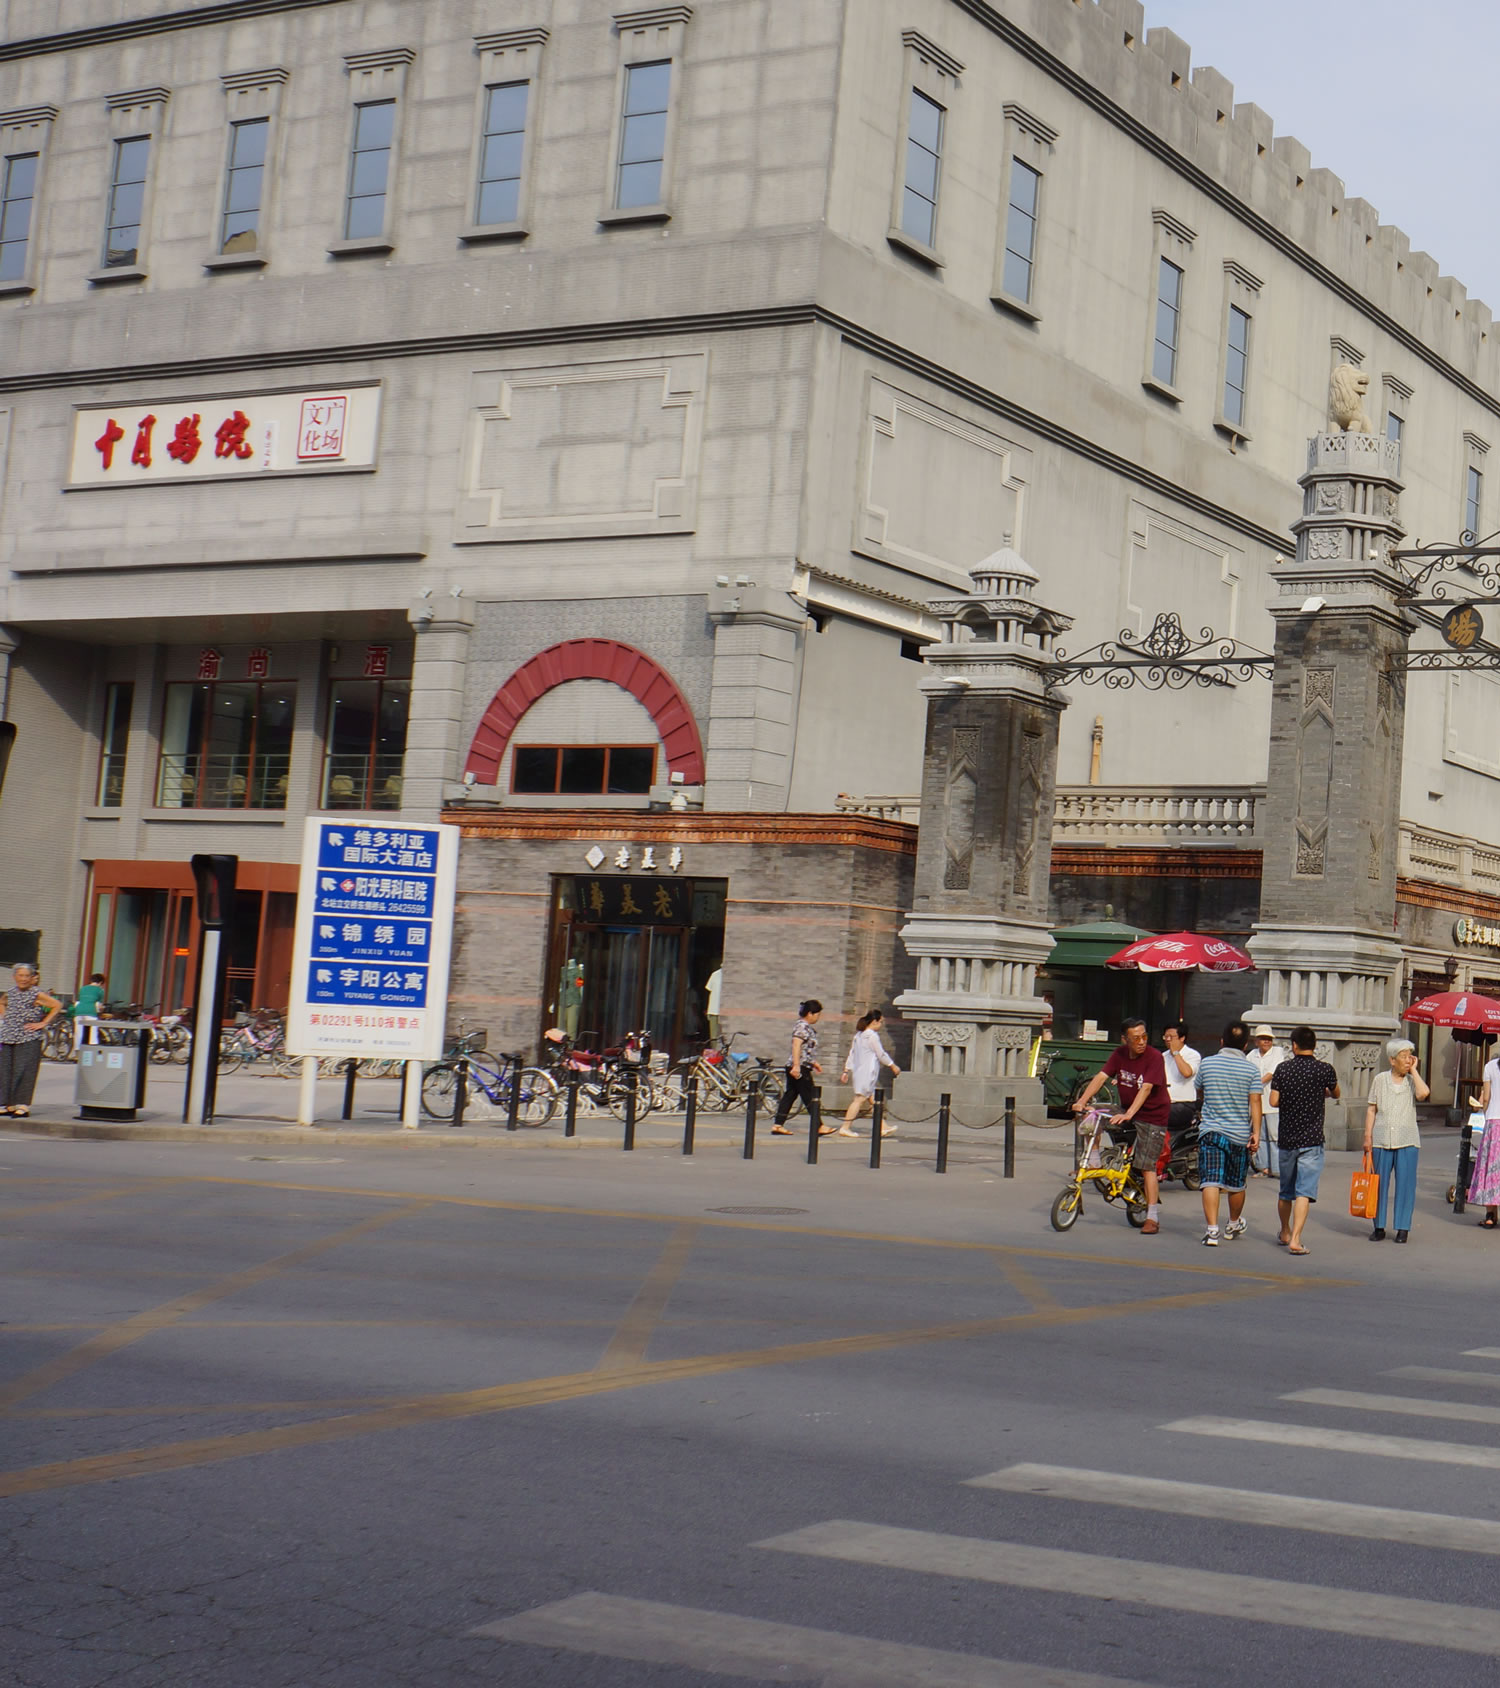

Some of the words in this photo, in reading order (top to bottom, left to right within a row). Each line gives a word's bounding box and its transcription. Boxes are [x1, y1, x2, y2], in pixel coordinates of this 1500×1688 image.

[95, 410, 254, 470] 十月影院
[354, 830, 425, 850] 维多利亚
[343, 847, 433, 868] 国际大酒店
[354, 876, 428, 901] 阳光男科医院
[342, 923, 426, 945] 锦绣园
[339, 968, 424, 991] 宇阳公寓
[344, 992, 375, 1000] YUYANG
[380, 994, 416, 1002] GONGYU
